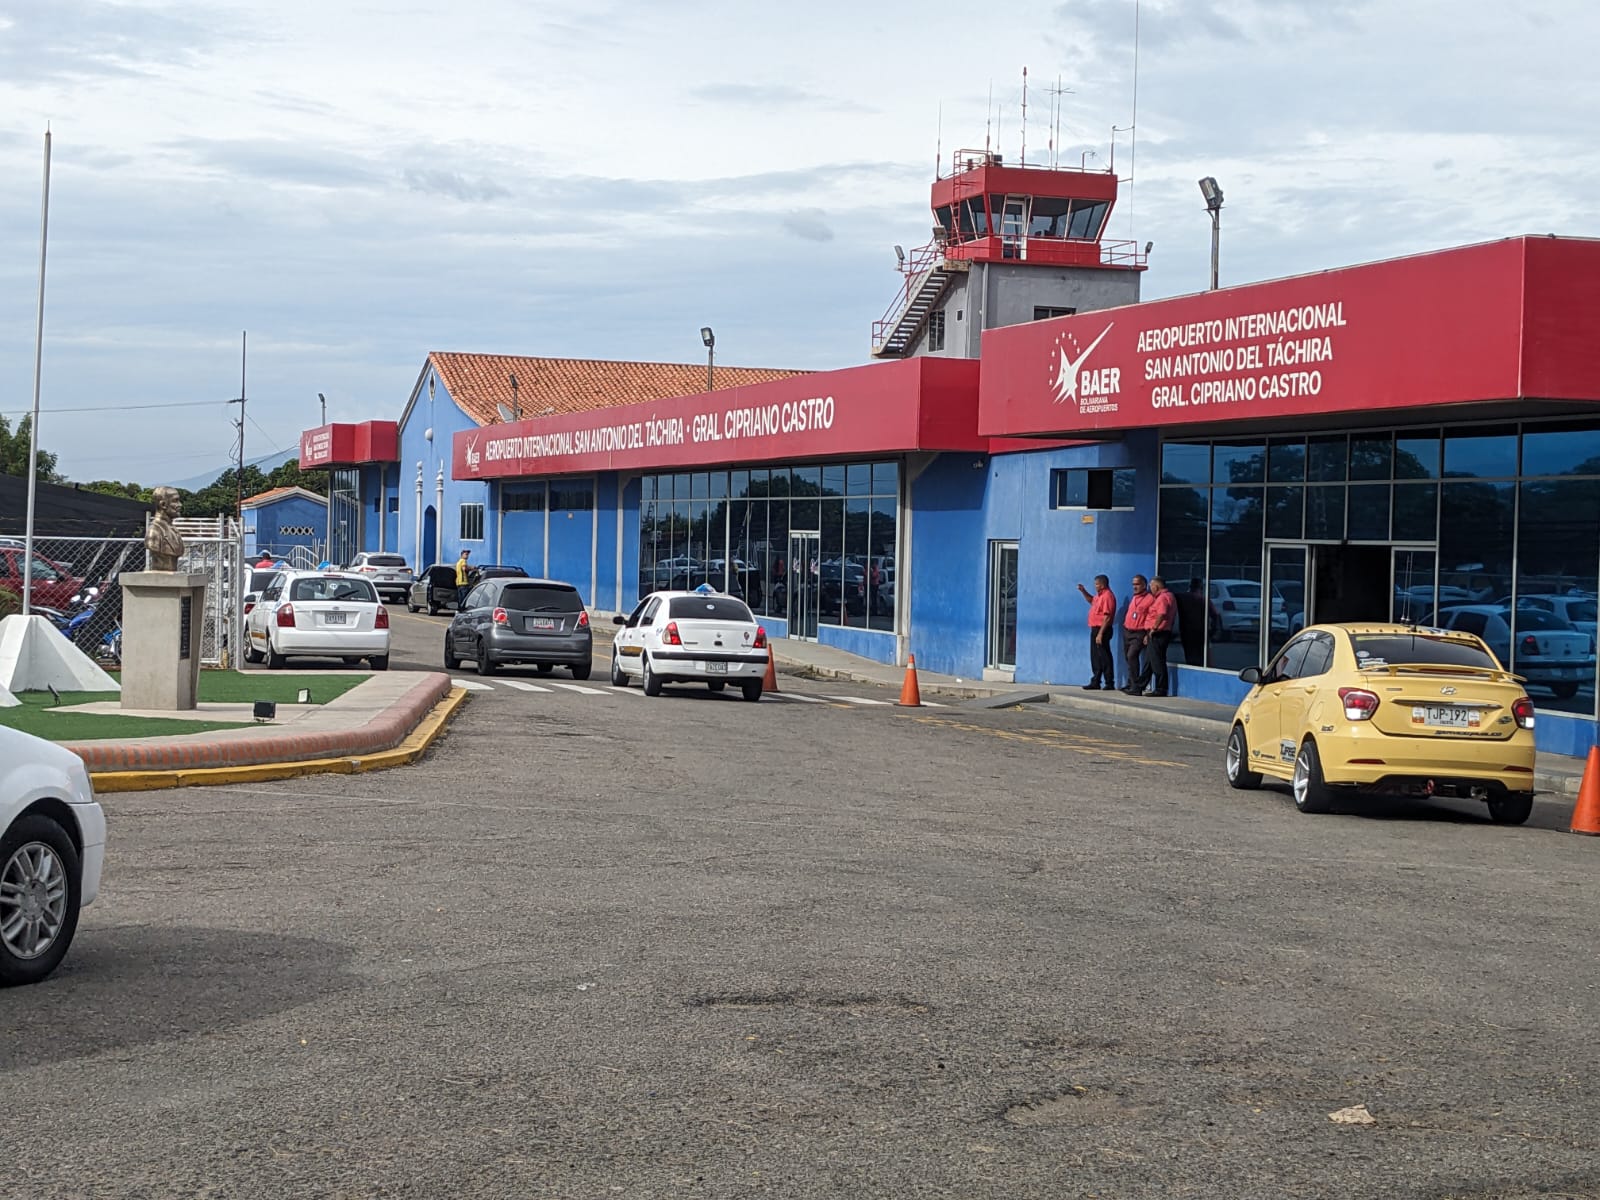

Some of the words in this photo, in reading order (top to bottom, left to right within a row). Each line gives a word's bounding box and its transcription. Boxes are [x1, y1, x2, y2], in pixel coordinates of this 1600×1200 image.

[1136, 320, 1223, 353] AEROPUERTO
[1224, 301, 1347, 342] INTERNACIONAL
[1144, 357, 1172, 381] SAN
[1172, 348, 1235, 378] ANTONIO
[1236, 345, 1264, 371] DEL
[1266, 336, 1333, 367] TÁCHIRA
[1080, 367, 1121, 397] BAER
[1151, 385, 1189, 409] GRAL.
[1190, 377, 1257, 405] CIPRIANO
[1258, 370, 1322, 400] CASTRO
[485, 435, 523, 461] AEROPUERTO
[522, 432, 574, 458] INTERNACIONAL
[574, 430, 592, 454] SAN
[590, 425, 627, 452] ANTONIO
[627, 424, 644, 449] DEL
[645, 413, 684, 447] TÁCHIRA
[692, 413, 723, 443] GRAL.
[724, 404, 780, 440] CIPRIANO
[781, 396, 835, 434] CASTRO
